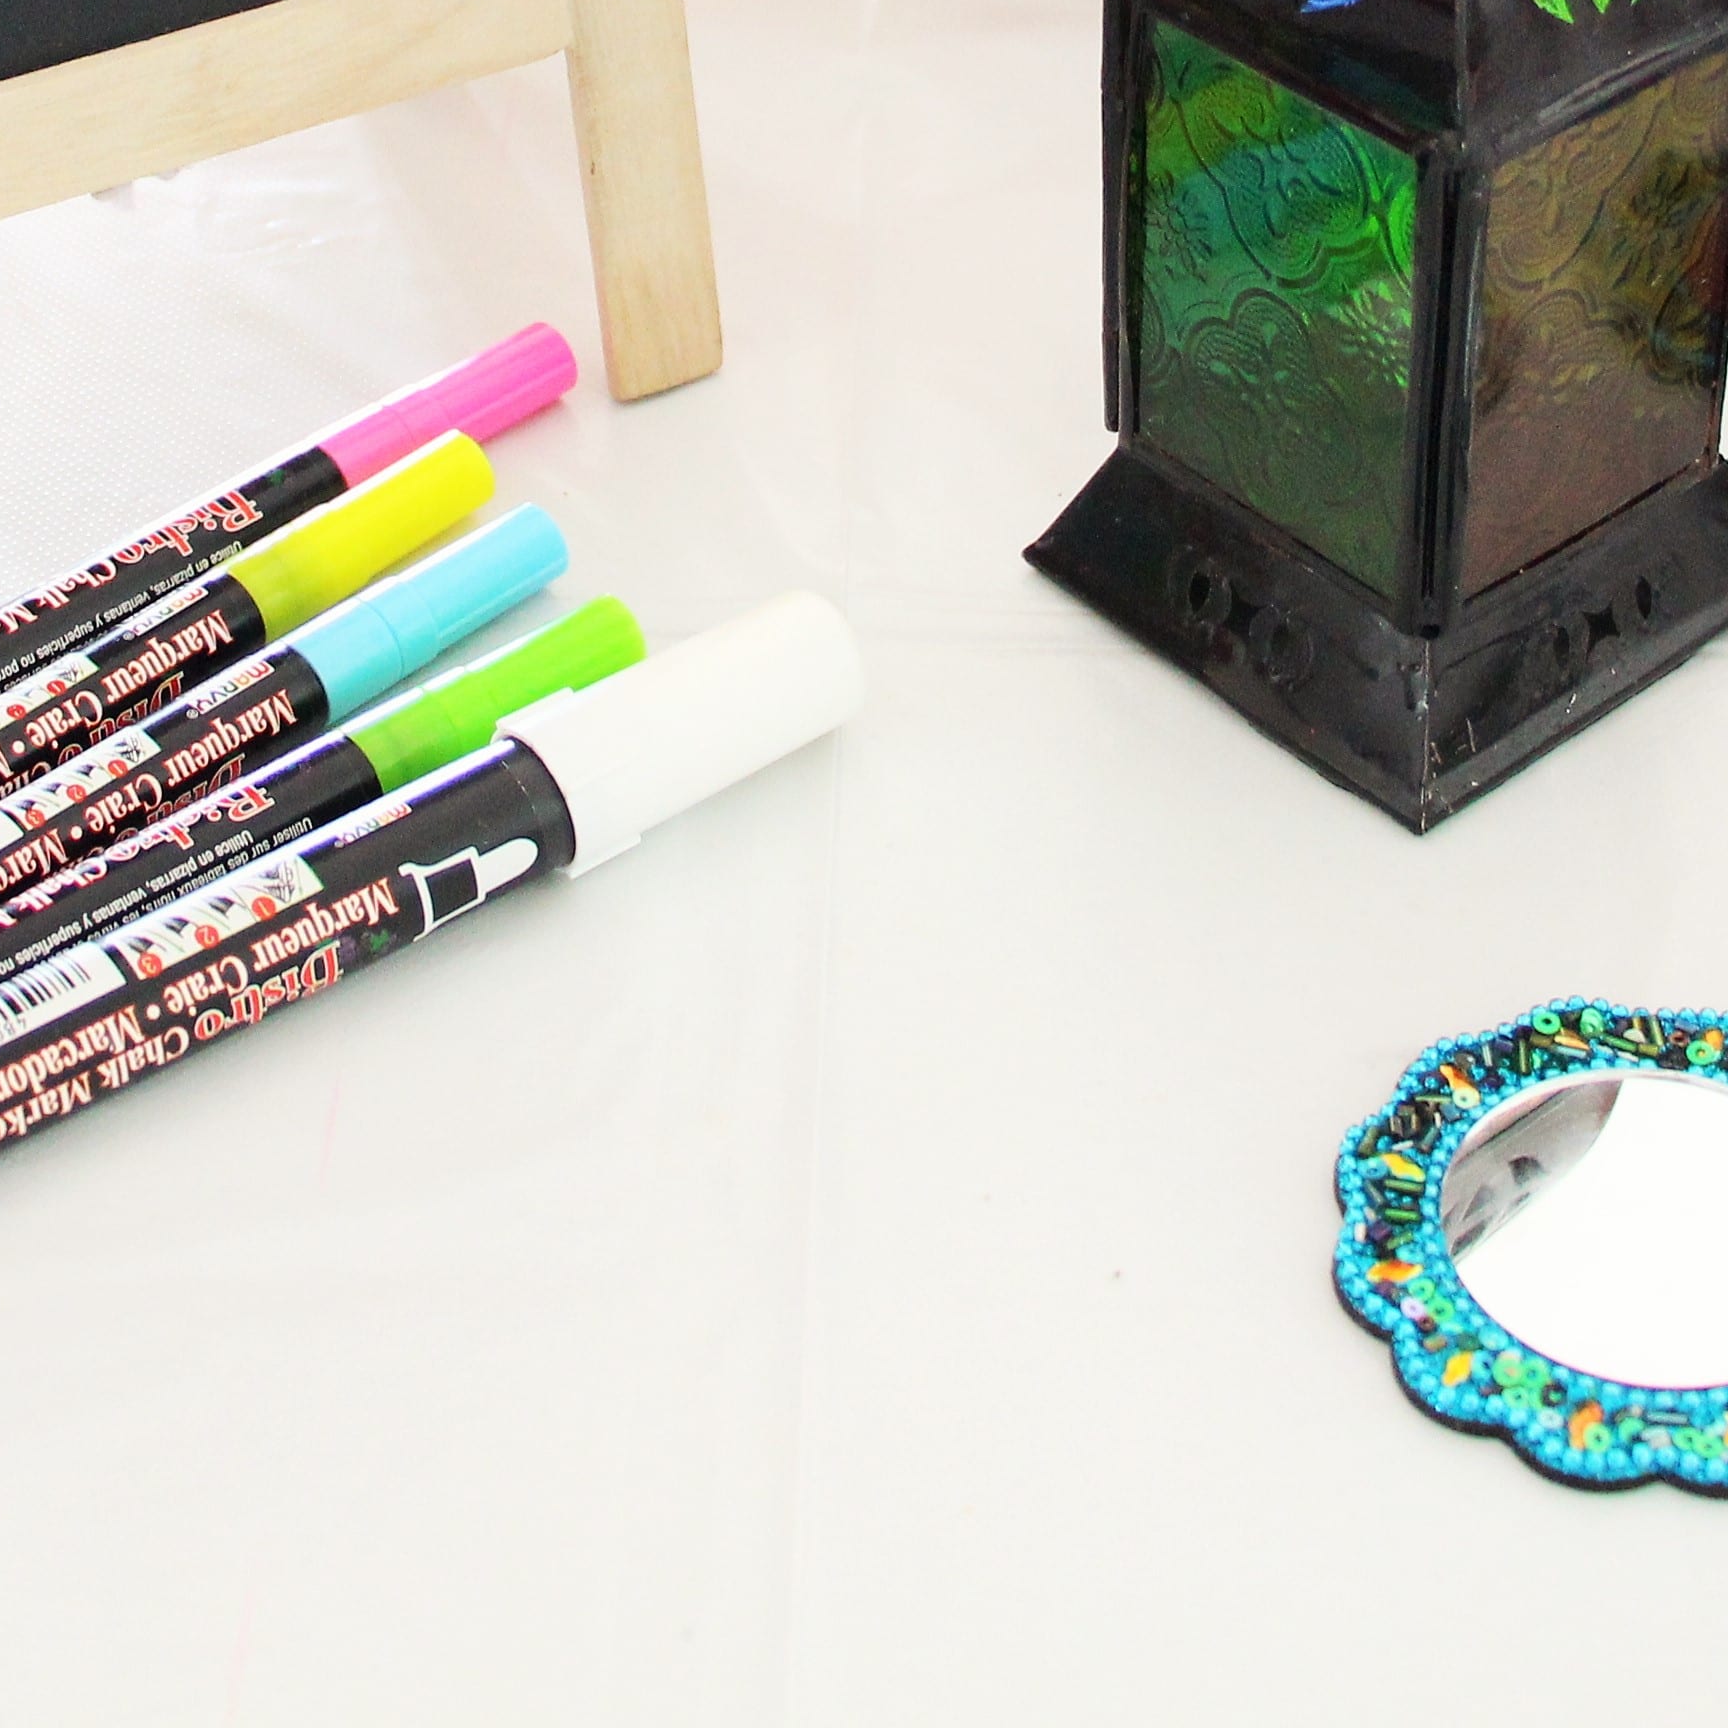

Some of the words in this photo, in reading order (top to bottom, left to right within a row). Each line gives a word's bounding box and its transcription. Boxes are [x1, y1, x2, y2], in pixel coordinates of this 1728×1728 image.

[93, 611, 230, 702] Marqueur
[26, 691, 102, 748] Craie
[160, 691, 294, 785] Marqueur
[84, 774, 162, 832] Craie
[252, 879, 397, 970] Marqueur
[164, 956, 248, 1015] Craie
[93, 1023, 187, 1090] Chalk
